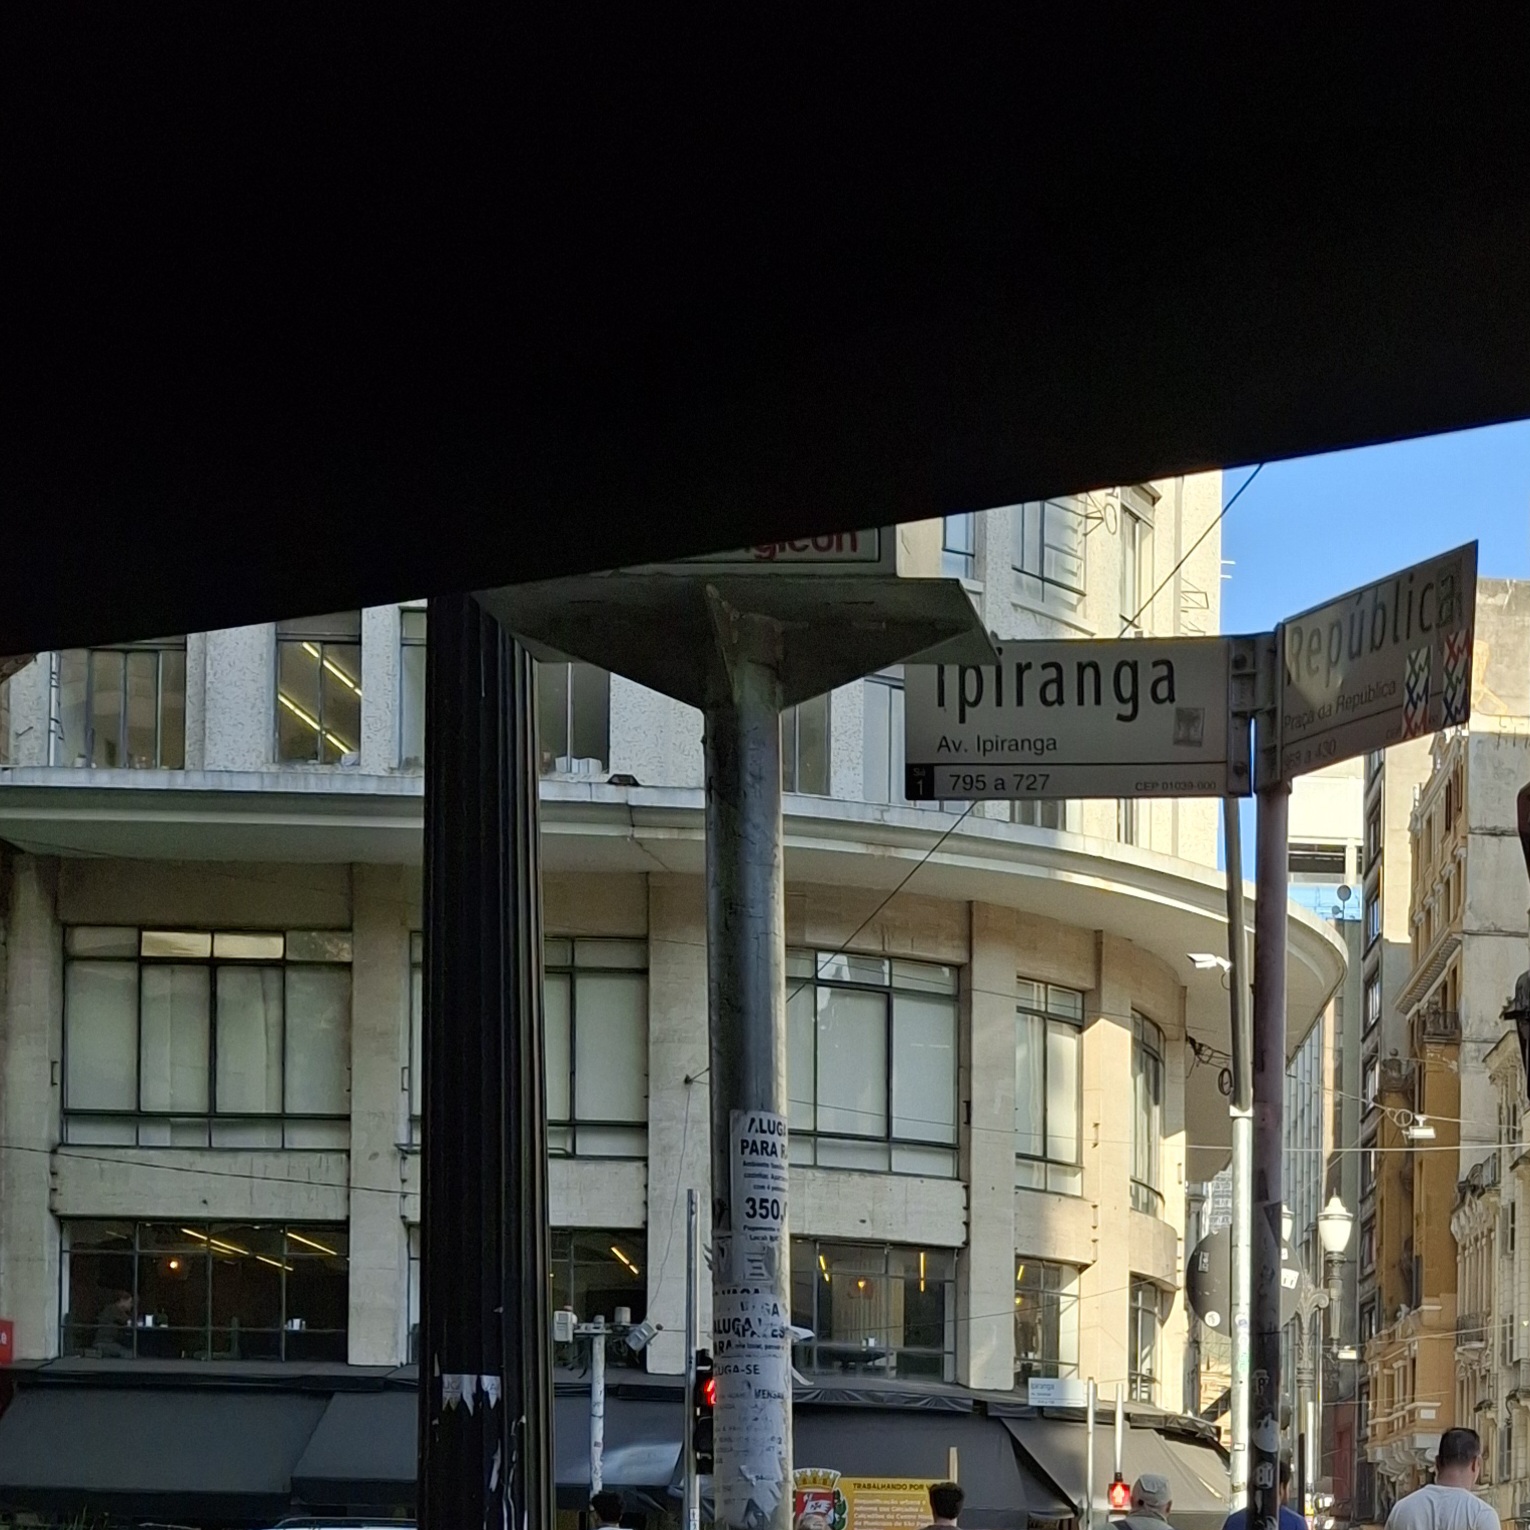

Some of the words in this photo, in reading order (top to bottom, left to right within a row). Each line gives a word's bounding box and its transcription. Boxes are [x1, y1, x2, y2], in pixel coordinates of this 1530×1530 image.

[936, 646, 1177, 724] Ipiranga
[1284, 709, 1315, 731] Praça
[1317, 702, 1332, 719] da
[1335, 679, 1397, 715] República
[937, 736, 968, 754] Av.
[976, 735, 1057, 757] Ipiranga
[916, 778, 923, 796] 1
[948, 774, 987, 792] 795
[993, 776, 1006, 792] a
[1013, 773, 1051, 791] 727
[1134, 781, 1160, 791] CEP
[1161, 780, 1217, 792] 01039-000
[740, 1138, 778, 1159] PARA
[852, 1482, 908, 1491] TRABALHANDO
